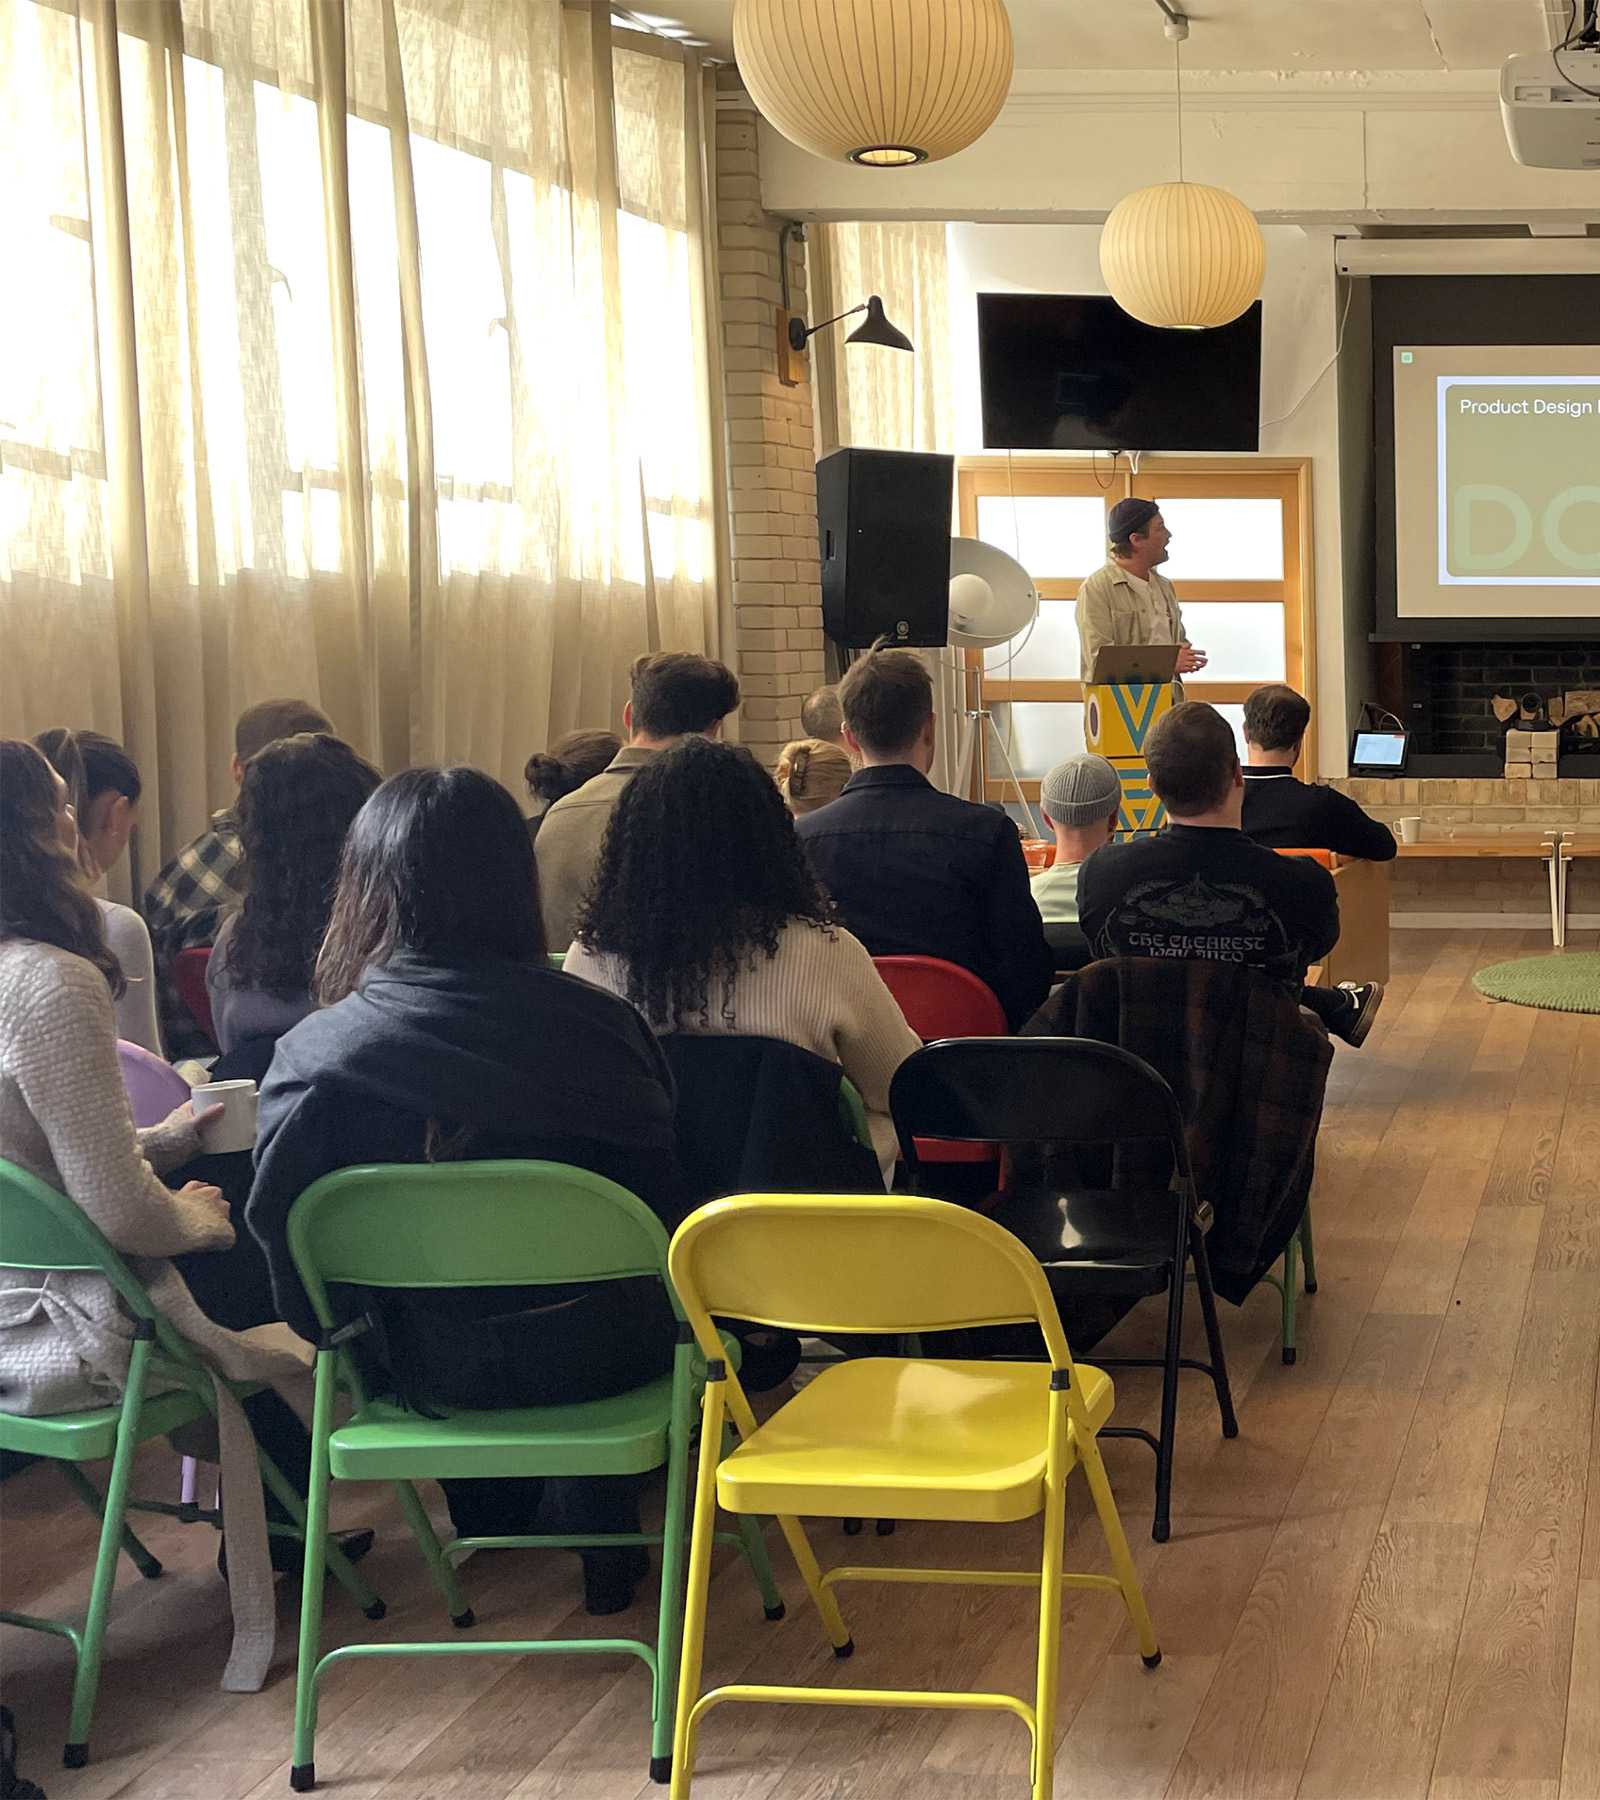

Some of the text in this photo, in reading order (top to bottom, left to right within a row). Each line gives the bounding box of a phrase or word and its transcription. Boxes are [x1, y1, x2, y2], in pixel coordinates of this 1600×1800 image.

[1460, 399, 1529, 415] Product
[1534, 399, 1593, 418] Design
[1129, 932, 1265, 950] THE CLEAREST
